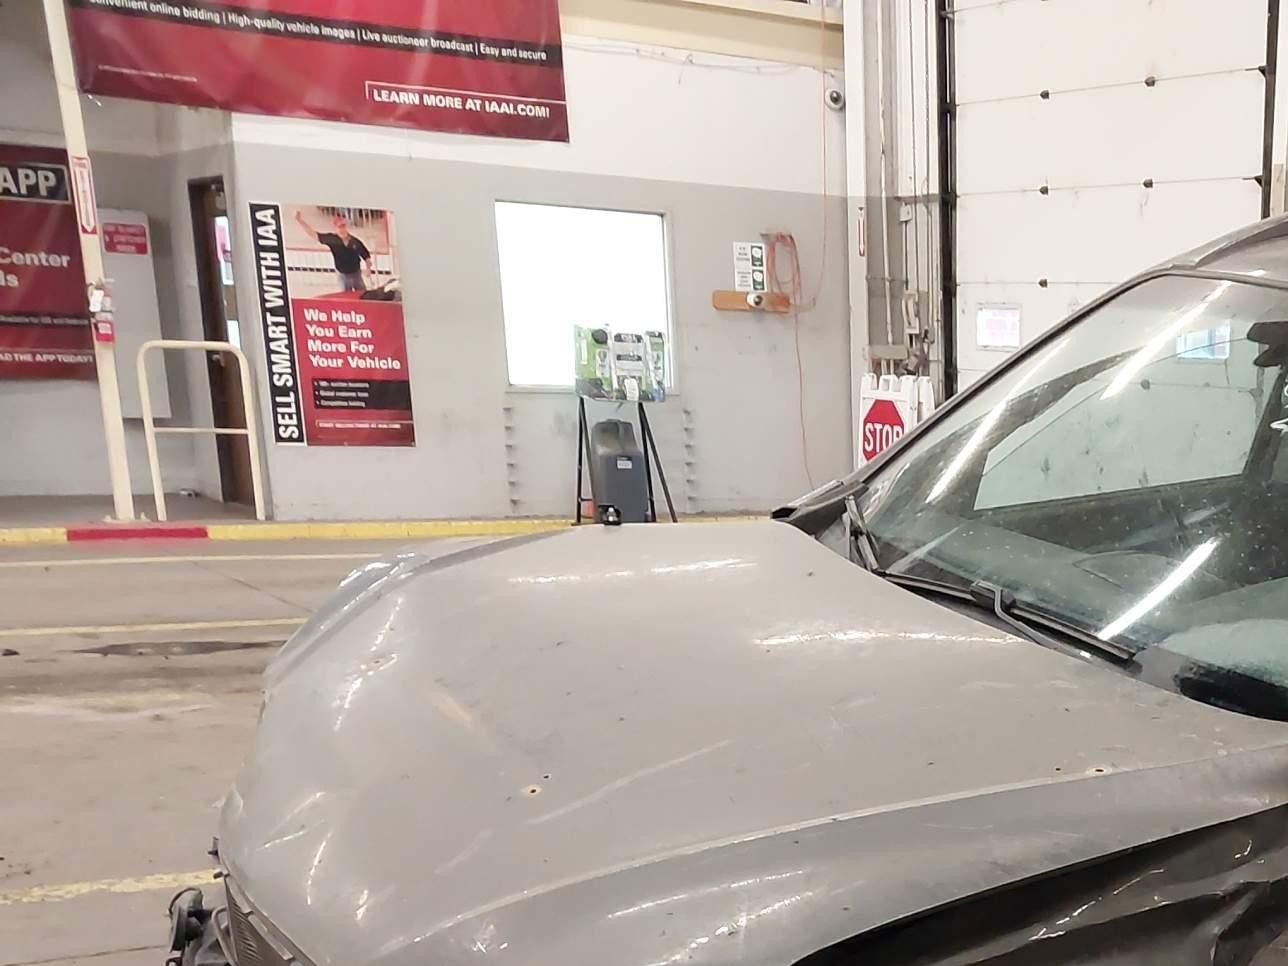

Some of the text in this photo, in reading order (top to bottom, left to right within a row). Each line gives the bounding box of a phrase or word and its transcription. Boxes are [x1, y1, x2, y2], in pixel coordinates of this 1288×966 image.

[150, 3, 180, 18] online
[183, 7, 220, 24] bidding
[228, 13, 285, 32] High-quality
[286, 20, 320, 35] vehicle
[321, 24, 355, 40] images
[362, 30, 380, 42] Live
[382, 32, 428, 48] auctioneer
[430, 37, 473, 53] broadcast
[480, 43, 499, 58] Easy
[501, 46, 518, 57] and
[518, 49, 547, 61] secure
[373, 88, 419, 105] LEARN
[423, 94, 462, 109] MORE
[465, 99, 482, 112] AT
[0, 168, 57, 196] APP
[255, 208, 300, 440] SELL SMART WITH IAA
[304, 308, 365, 325] We Help
[306, 324, 372, 339] You Earn
[308, 340, 375, 354] More For
[310, 355, 401, 370] Your Vehicle
